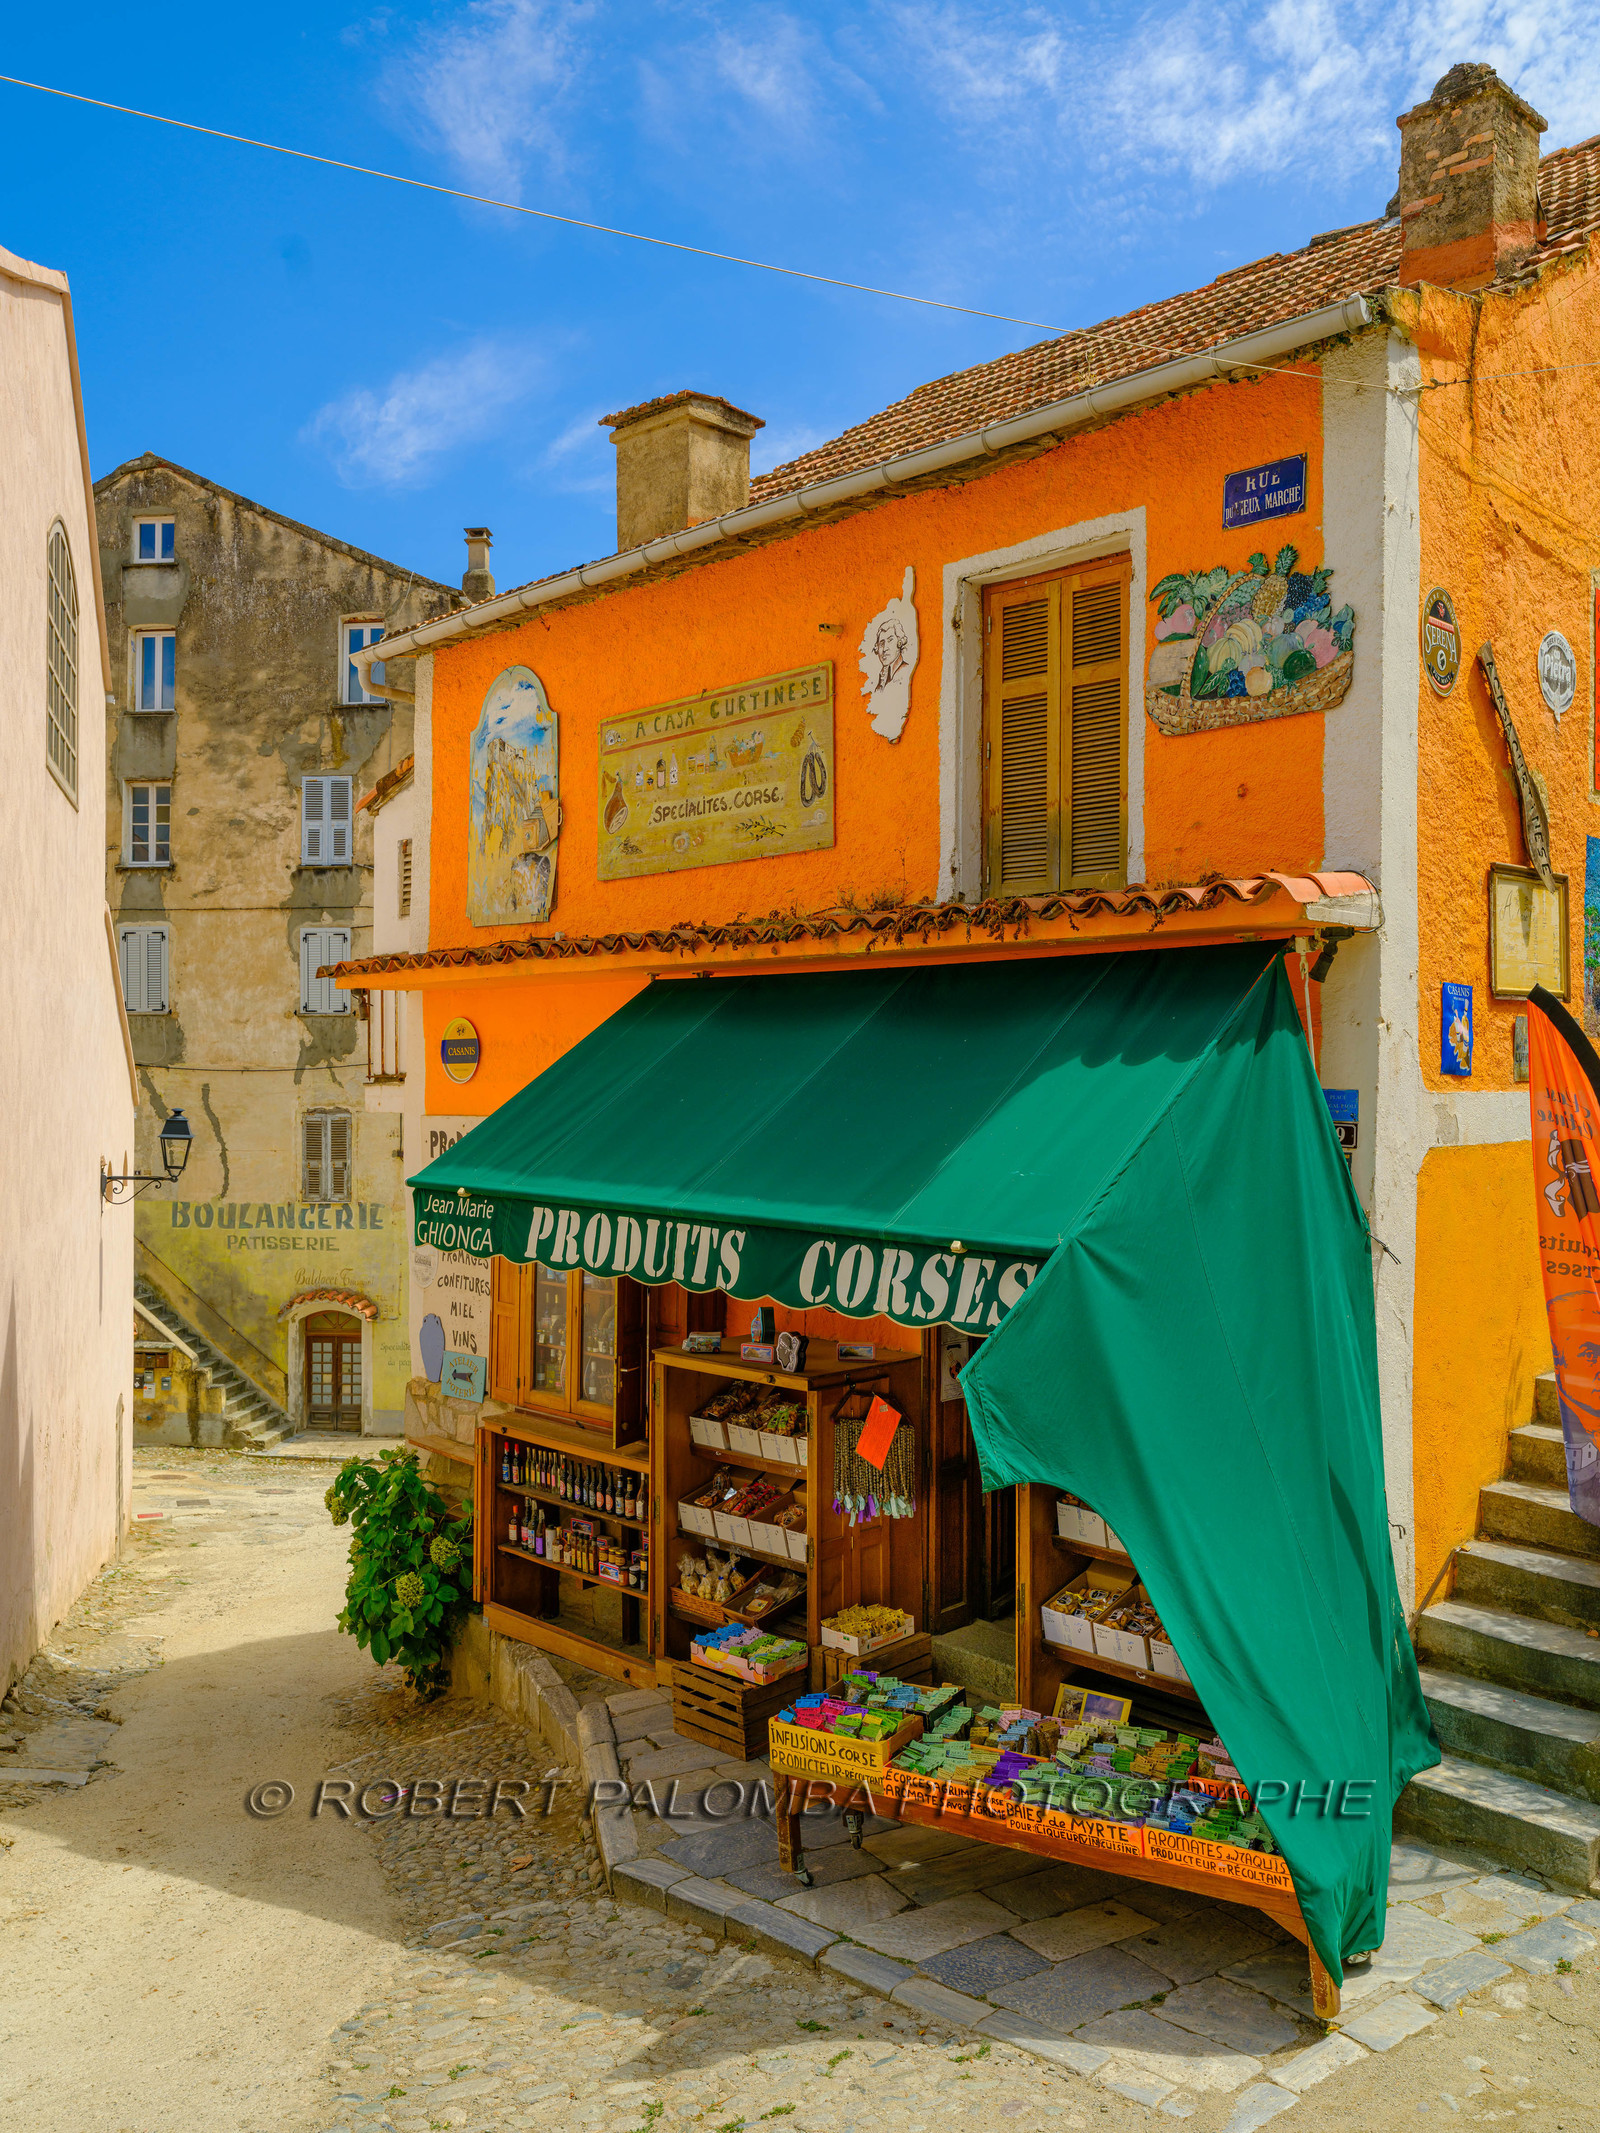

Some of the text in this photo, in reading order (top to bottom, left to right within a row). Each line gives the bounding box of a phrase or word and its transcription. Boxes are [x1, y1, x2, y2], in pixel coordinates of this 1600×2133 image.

[1245, 471, 1280, 492] RUE
[1225, 507, 1234, 520] DU
[1425, 623, 1458, 664] SERENA
[1543, 653, 1571, 690] Pietra
[635, 676, 822, 738] A CASA CURTINESE
[1447, 985, 1470, 997] CASANIS
[447, 1046, 476, 1056] CASANIS
[171, 1201, 385, 1230] BOULANGERIE
[424, 1194, 494, 1219] Jean Marie
[227, 1235, 339, 1251] PATISSERIE
[417, 1220, 494, 1253] GHIONGA
[524, 1206, 746, 1290] PRODUITS
[437, 1272, 491, 1297] CONFITURES
[799, 1240, 1038, 1326] CORSES
[450, 1301, 474, 1319] MIEL
[452, 1330, 478, 1354] VINS
[449, 1356, 479, 1375] ATELIER
[446, 1378, 477, 1398] POTERIE
[770, 1724, 877, 1768] INFUSIONS CORSE
[1006, 1802, 1129, 1842] BAIES de MYRTE
[1100, 1841, 1138, 1856] CUISINE
[1148, 1830, 1223, 1859] AROMATES
[1151, 1846, 1217, 1871] PRODUCTEUR
[1227, 1864, 1290, 1888] RÉCOLTANT
